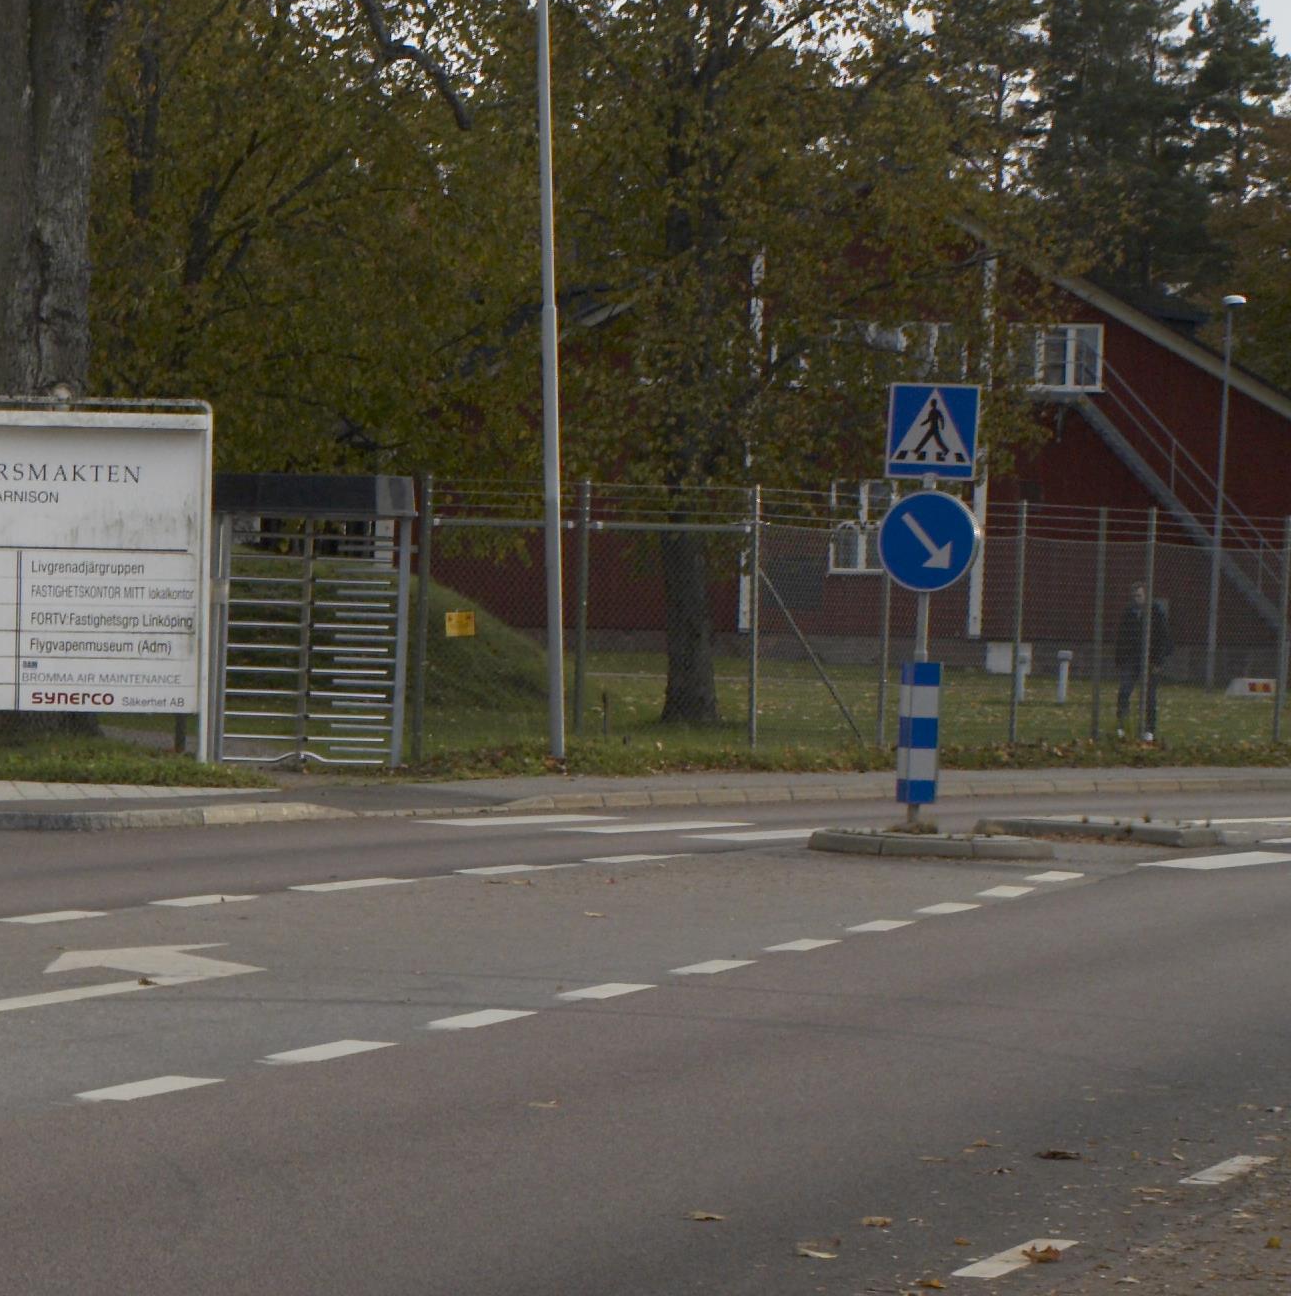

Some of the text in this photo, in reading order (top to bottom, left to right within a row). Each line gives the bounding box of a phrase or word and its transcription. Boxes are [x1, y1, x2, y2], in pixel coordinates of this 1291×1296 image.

[31, 561, 145, 576] Livgrenadjärgruppen
[31, 585, 121, 600] FASTIGHETSKONTOR
[123, 587, 146, 600] MITT
[142, 615, 194, 630] Linköping
[30, 638, 172, 656] Flygvapenmuseum (Adm)
[22, 672, 181, 685] BROMMA AIR MAINTENANCE
[169, 698, 185, 708] AB
